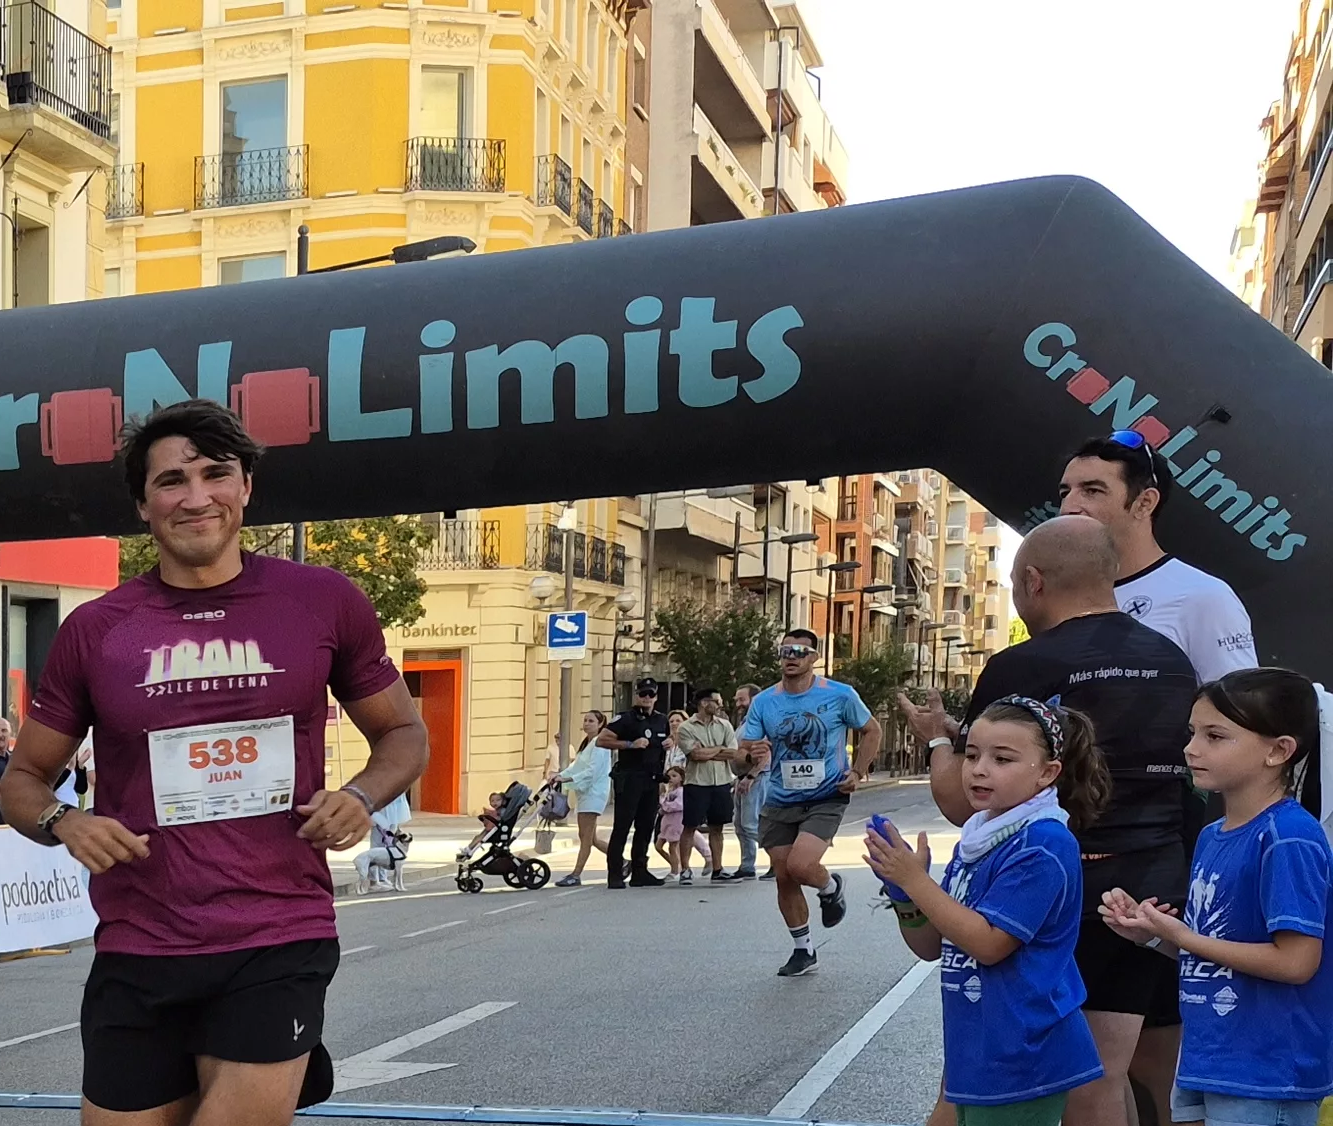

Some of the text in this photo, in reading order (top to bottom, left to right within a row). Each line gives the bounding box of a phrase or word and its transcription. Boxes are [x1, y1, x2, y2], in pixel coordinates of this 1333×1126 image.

[401, 622, 478, 639] bankinter
[144, 638, 276, 686] TRAIL
[200, 678, 219, 691] DE
[227, 674, 269, 689] TENA
[1069, 666, 1160, 685] Más rápido que ayer
[188, 735, 259, 770] 538
[207, 769, 243, 784] JUAN
[791, 764, 814, 775] 140
[1, 868, 81, 926] podoactiva
